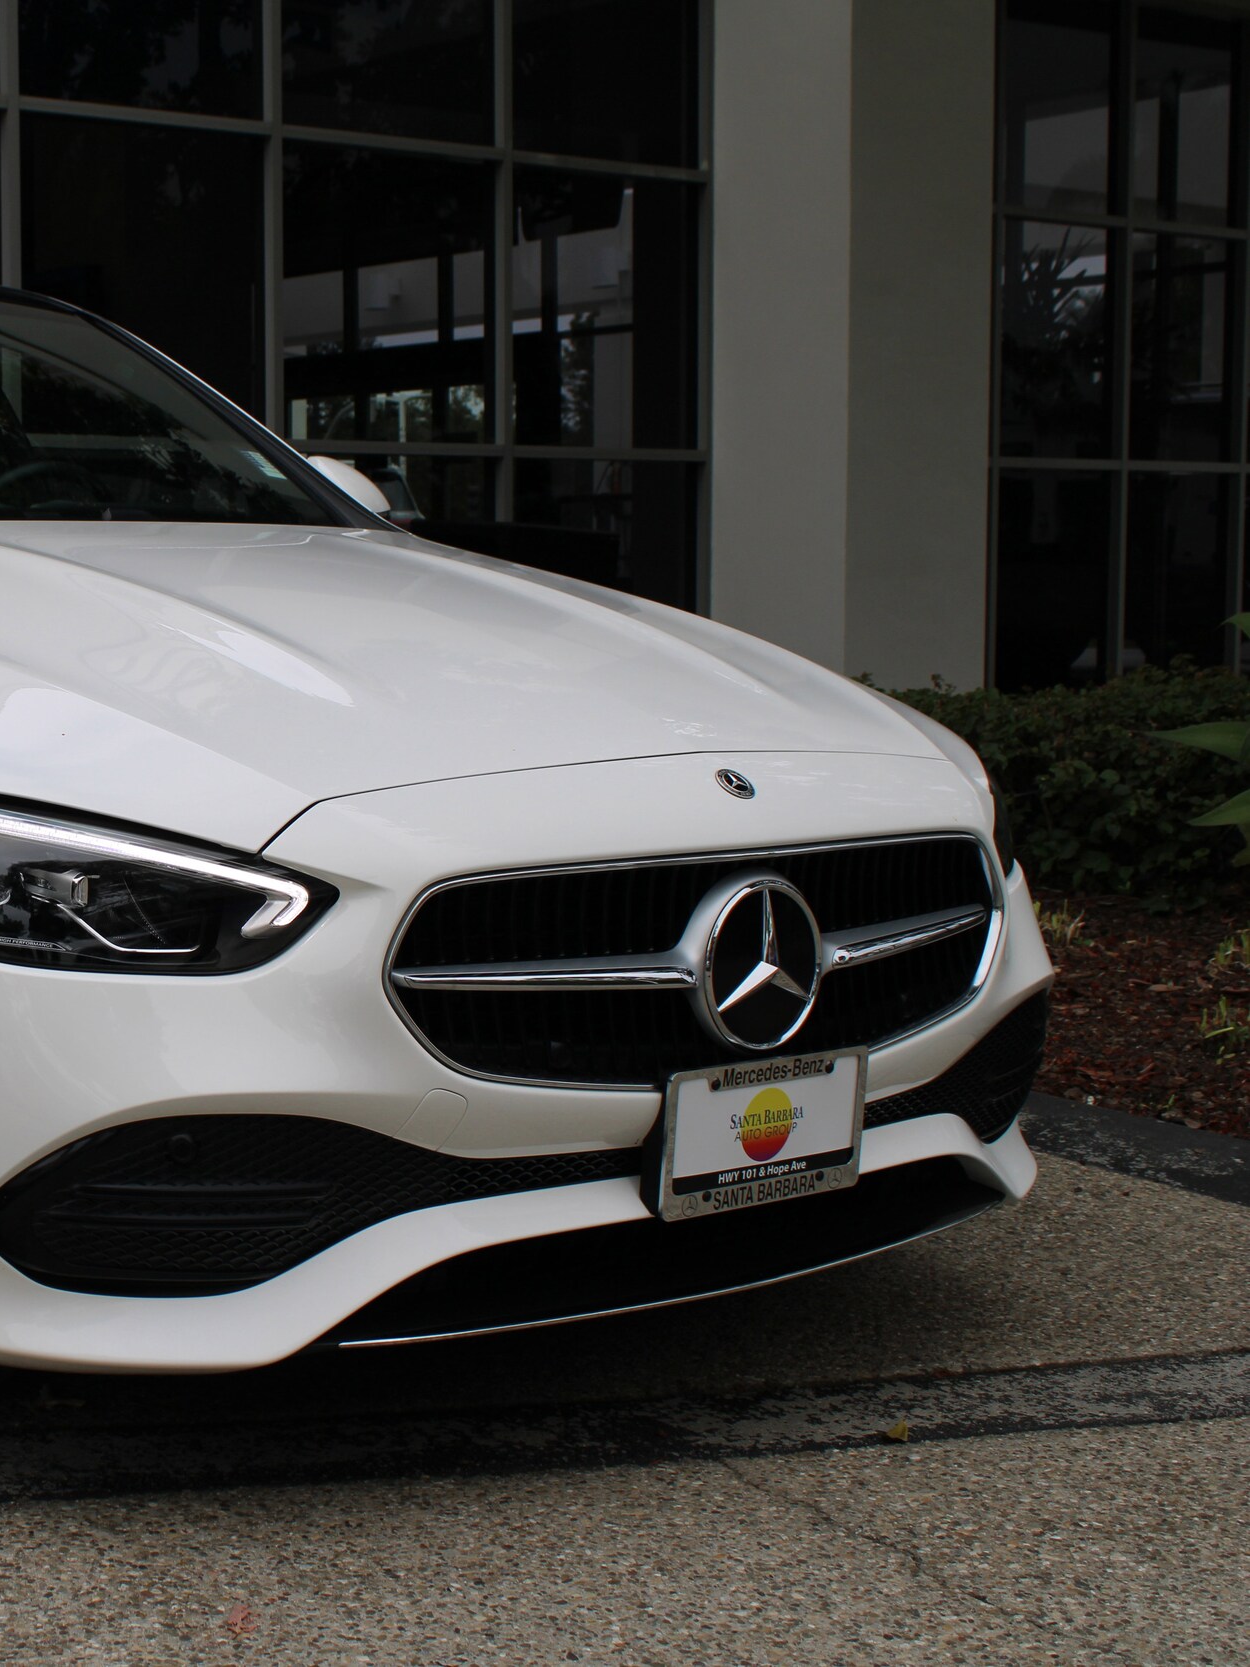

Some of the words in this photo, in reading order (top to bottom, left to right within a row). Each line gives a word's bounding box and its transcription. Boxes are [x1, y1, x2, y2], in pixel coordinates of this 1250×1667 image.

[723, 1059, 824, 1087] Mercedes-Benz
[729, 1112, 762, 1130] SANTA
[763, 1106, 804, 1125] BARBARA
[734, 1128, 762, 1143] AUTO
[764, 1121, 798, 1138] GROUP
[717, 1170, 740, 1184] HWY
[741, 1168, 757, 1180] 101
[758, 1166, 765, 1177] &
[766, 1163, 789, 1176] Hope
[790, 1160, 807, 1172] Ave
[713, 1184, 754, 1210] SANTA
[757, 1174, 815, 1201] BARBARA
